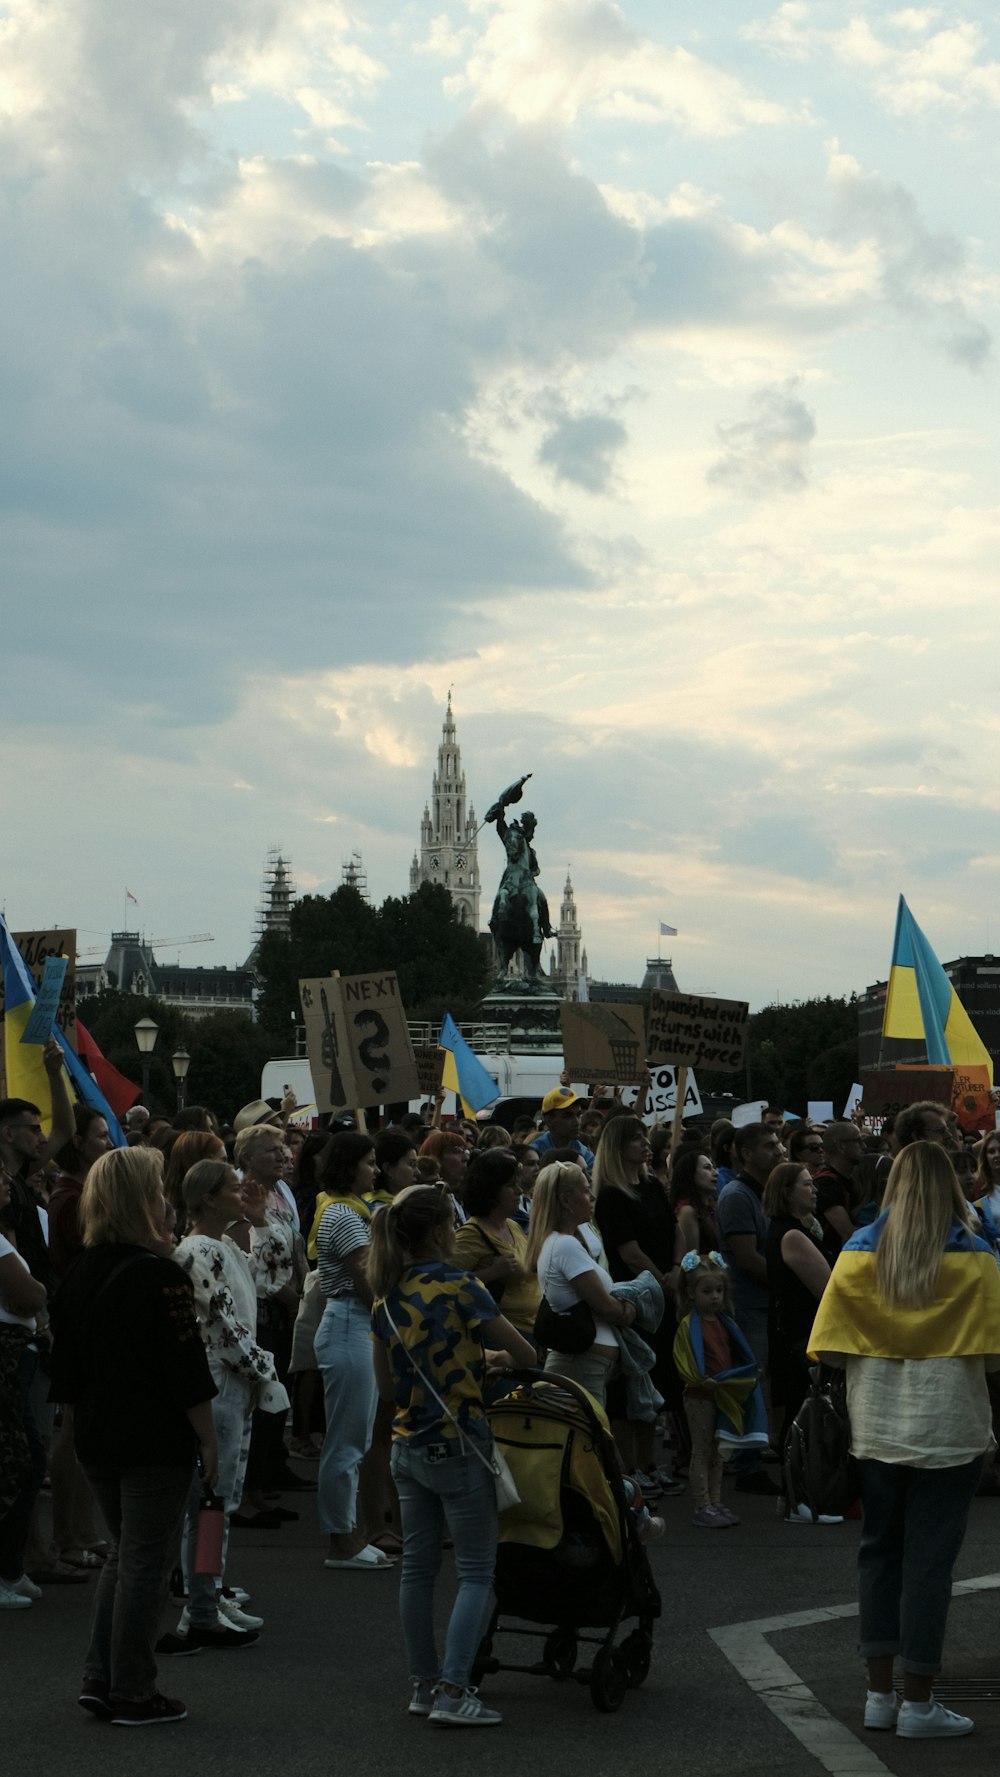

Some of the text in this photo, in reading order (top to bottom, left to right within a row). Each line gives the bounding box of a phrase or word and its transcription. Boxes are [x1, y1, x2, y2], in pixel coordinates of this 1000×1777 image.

[346, 976, 396, 1001] NEXT
[652, 992, 749, 1024] Unpunished evil
[651, 1017, 742, 1046] returns with
[648, 1034, 742, 1067] greater force
[417, 1072, 440, 1082] URED
[629, 1086, 698, 1117] USSA
